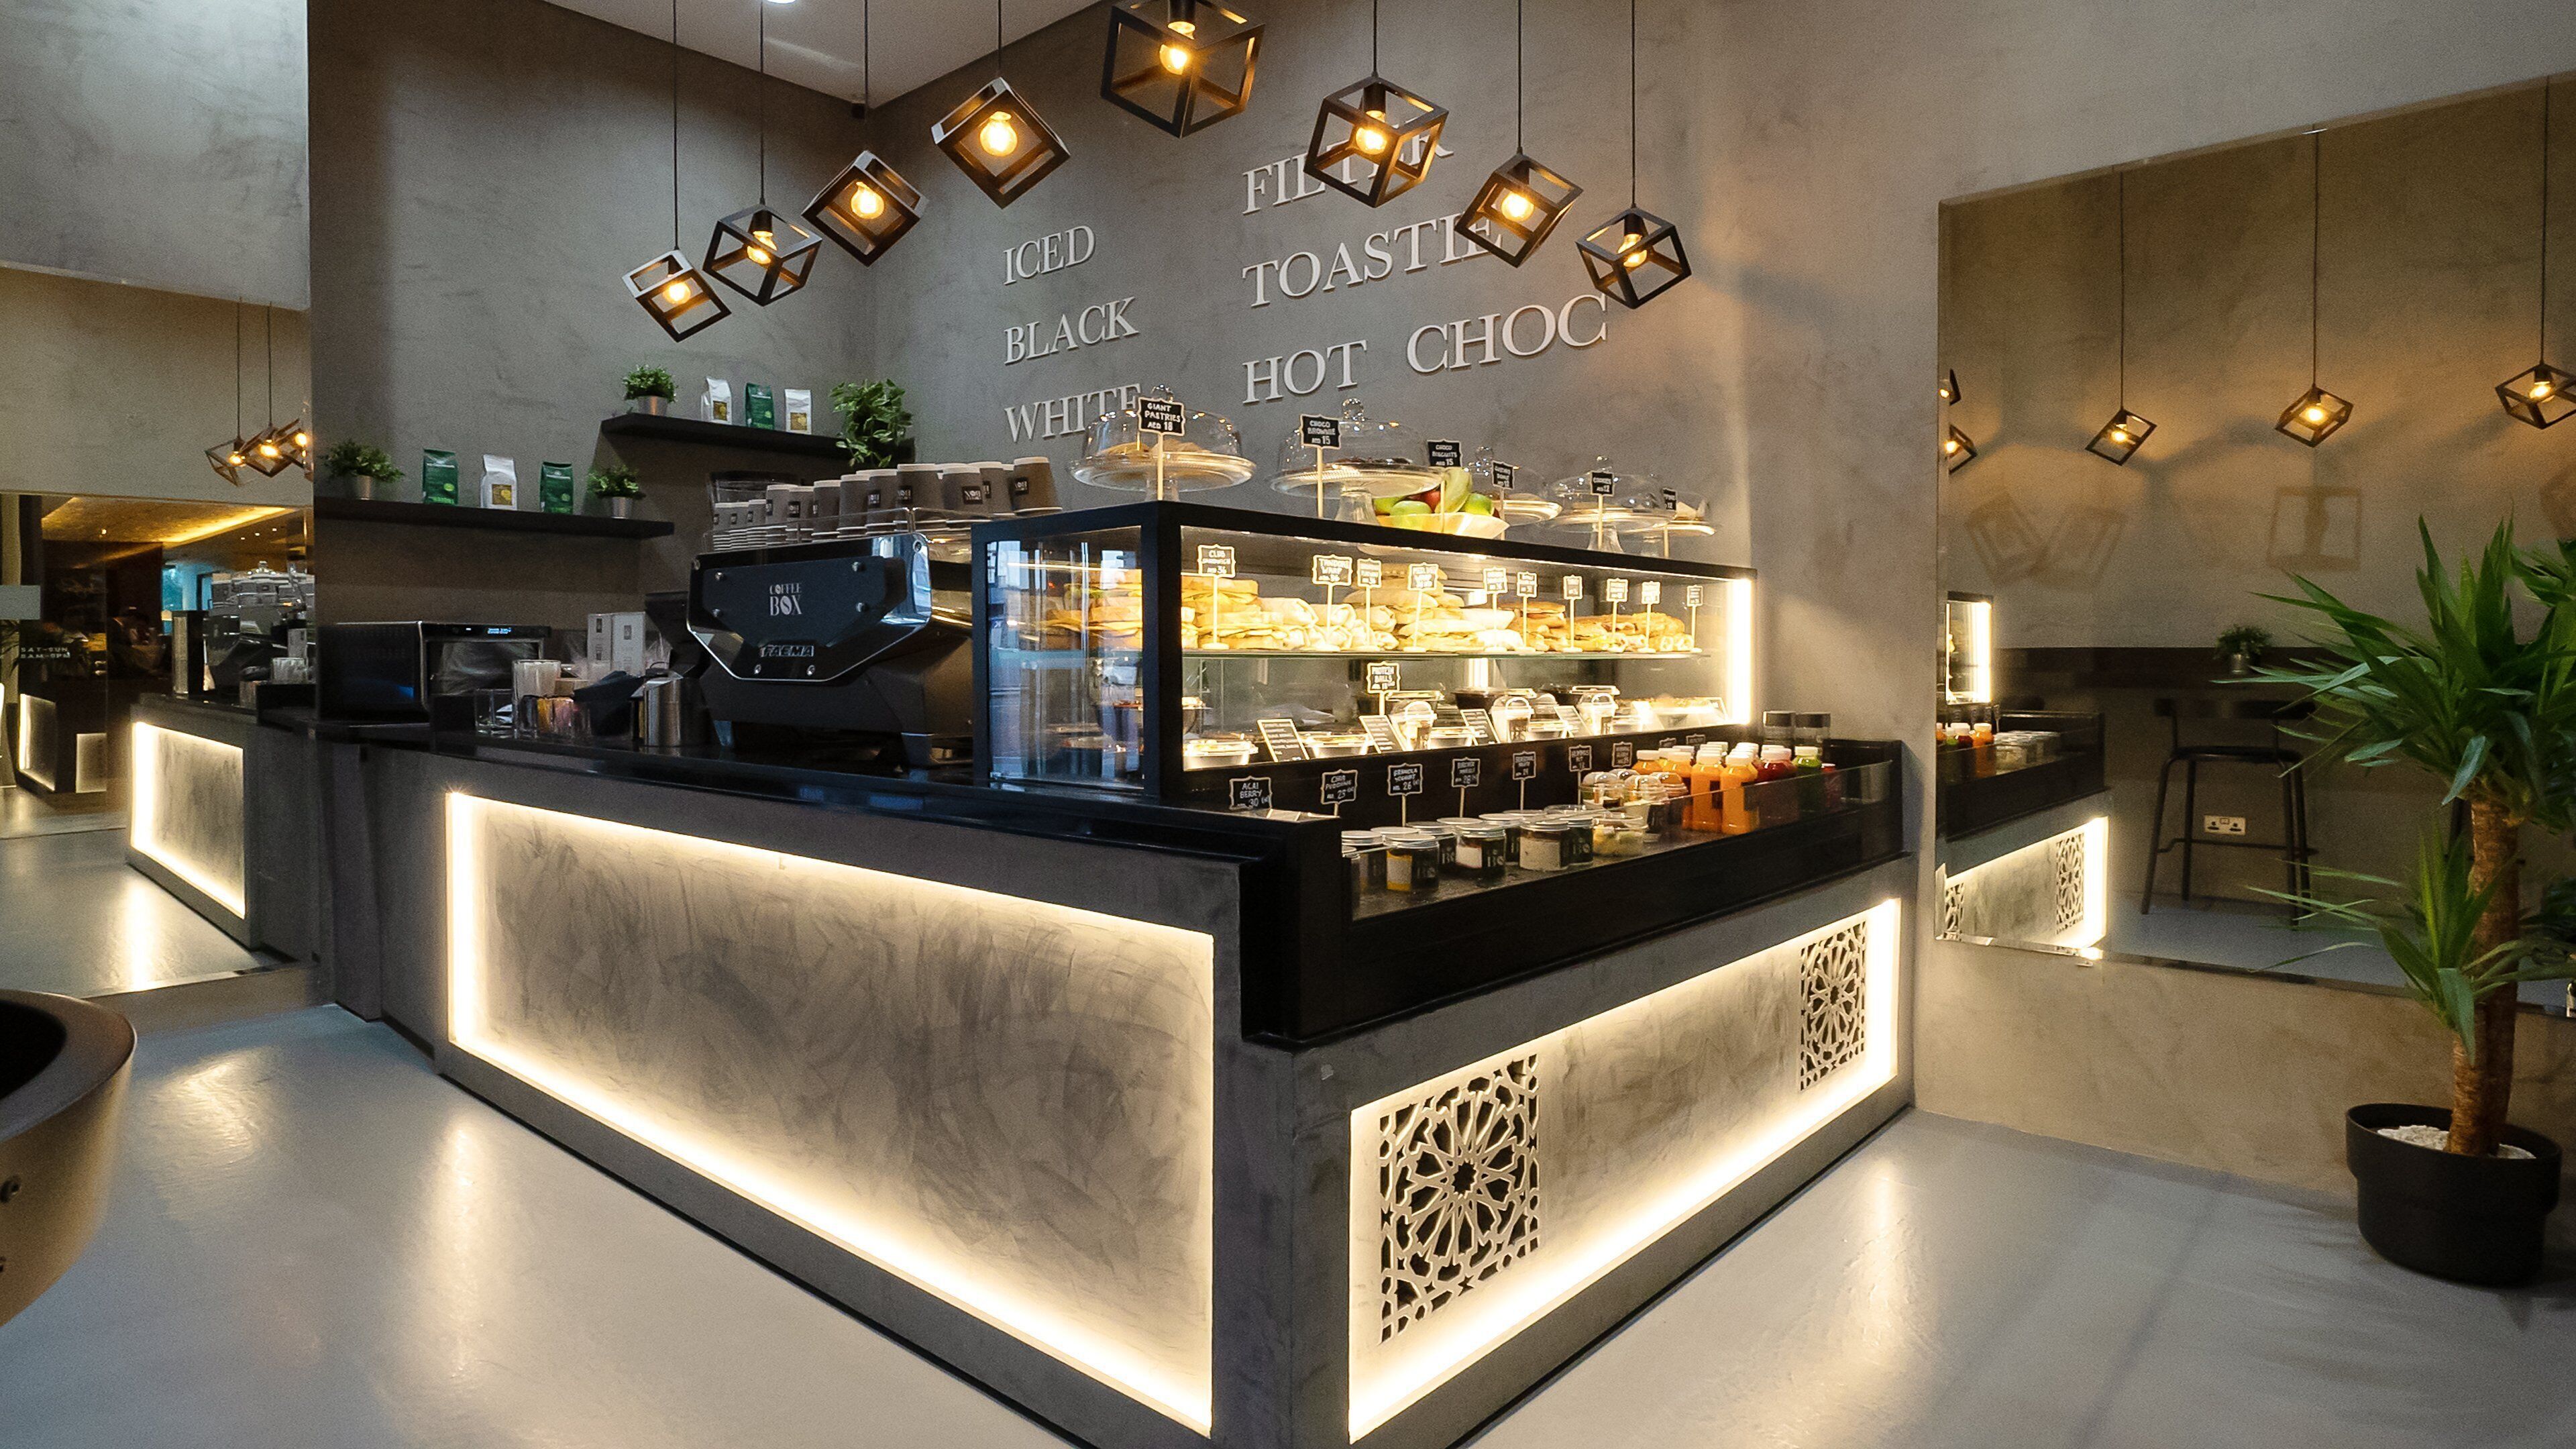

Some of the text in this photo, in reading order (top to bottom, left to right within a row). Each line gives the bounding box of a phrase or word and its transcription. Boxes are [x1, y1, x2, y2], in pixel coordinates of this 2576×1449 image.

[1242, 122, 1454, 215] FILTR
[1003, 225, 1095, 286] ICED
[1004, 297, 1139, 365] BLACK
[1242, 294, 1608, 404] HOT CHOC
[1147, 402, 1171, 412] GIANT
[1004, 383, 1140, 443] WHITE
[1144, 410, 1181, 423] PASTRIES
[1147, 421, 1173, 431] AED 18
[1309, 420, 1330, 428] CHOCO
[1322, 435, 1331, 445] 15
[1208, 549, 1226, 558] CLUB
[1217, 565, 1228, 574] 36
[769, 582, 802, 595] COFFEE
[769, 594, 803, 616] BOX
[760, 645, 814, 657] FAEMA
[1242, 782, 1259, 790] ACAI
[1403, 781, 1412, 790] 26
[1240, 789, 1263, 799] BERRY
